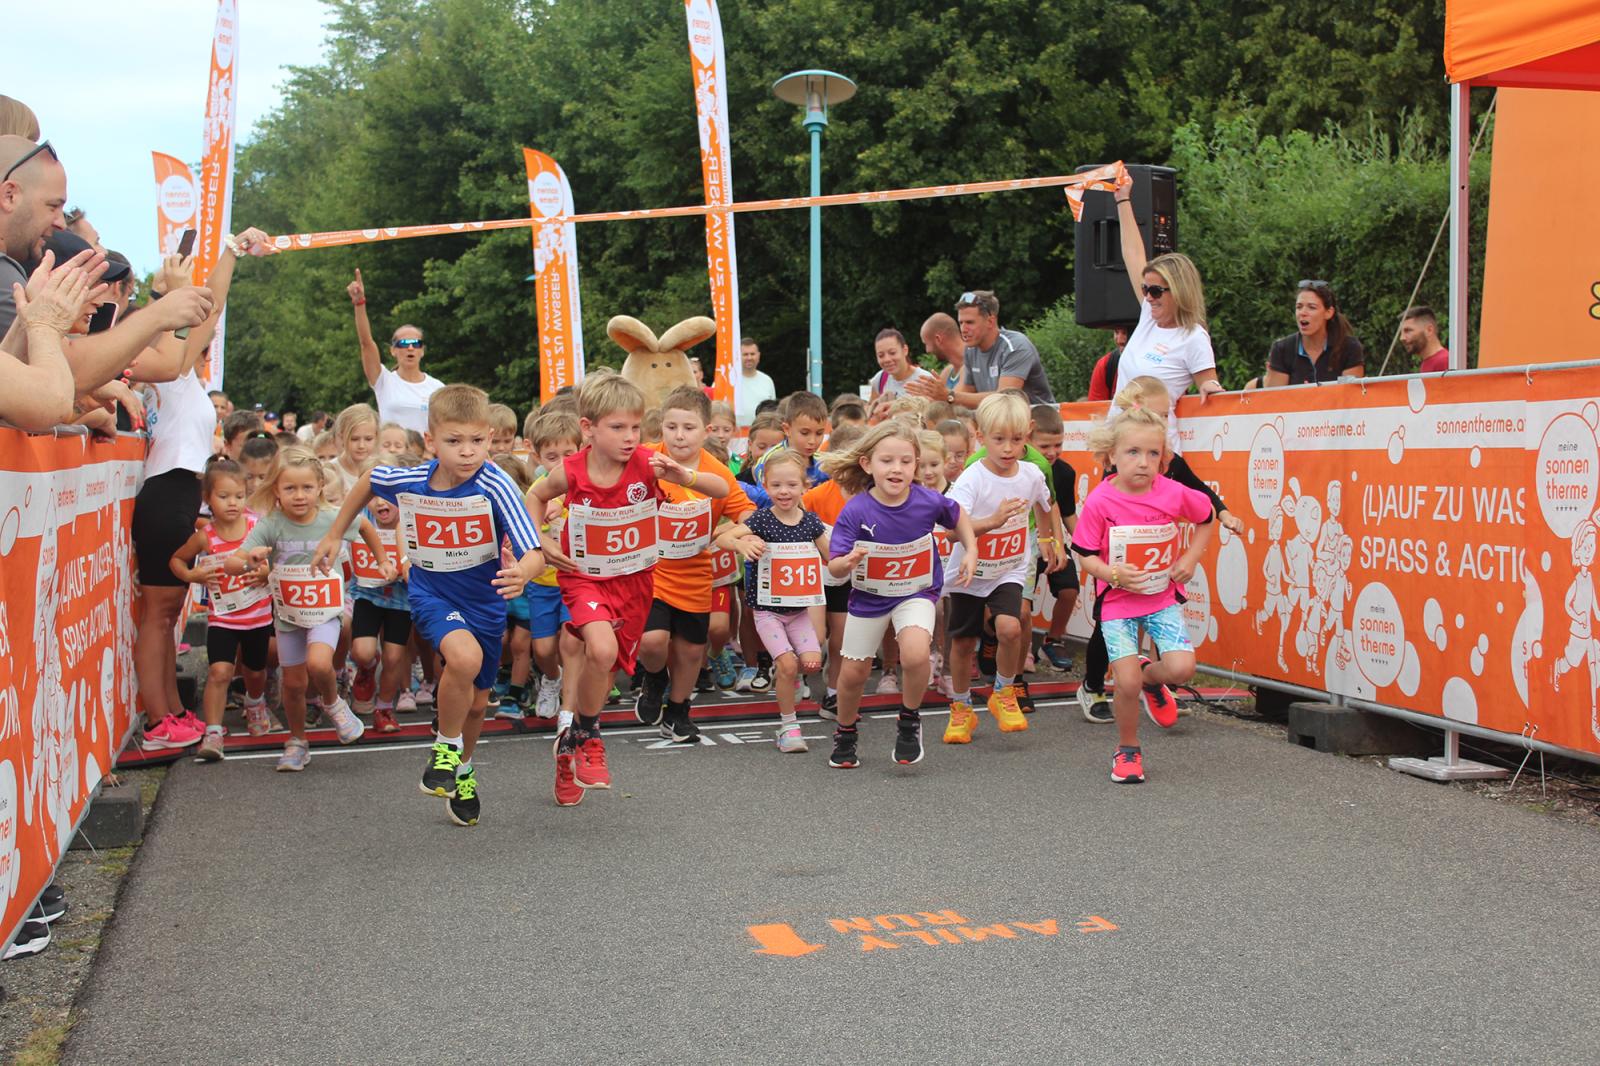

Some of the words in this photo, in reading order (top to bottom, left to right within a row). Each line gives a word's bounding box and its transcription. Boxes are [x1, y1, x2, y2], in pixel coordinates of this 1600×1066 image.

[1297, 420, 1366, 438] sonnentherme.at
[1558, 441, 1578, 452] meine
[1253, 459, 1279, 471] sonnen
[1546, 457, 1589, 475] sonnen
[1253, 473, 1278, 490] therme
[1545, 479, 1588, 500] therme
[420, 498, 445, 508] FAMILY
[1362, 485, 1427, 526] (L)AUF
[1433, 486, 1464, 522] ZU
[591, 510, 618, 518] FAMILY
[425, 520, 484, 545] 215
[606, 527, 640, 553] 50
[671, 520, 698, 540] 72
[986, 533, 1022, 558] 179
[606, 553, 641, 564] Jonathan
[1143, 543, 1173, 571] 24
[1359, 536, 1428, 574] SPASS
[1436, 542, 1452, 577] &
[779, 564, 817, 587] 315
[885, 558, 918, 578] 27
[287, 583, 331, 606] 251
[1359, 618, 1396, 635] sonnen
[1360, 633, 1396, 657] therme
[828, 908, 970, 934] RUN
[860, 914, 1120, 952] FAMILY
